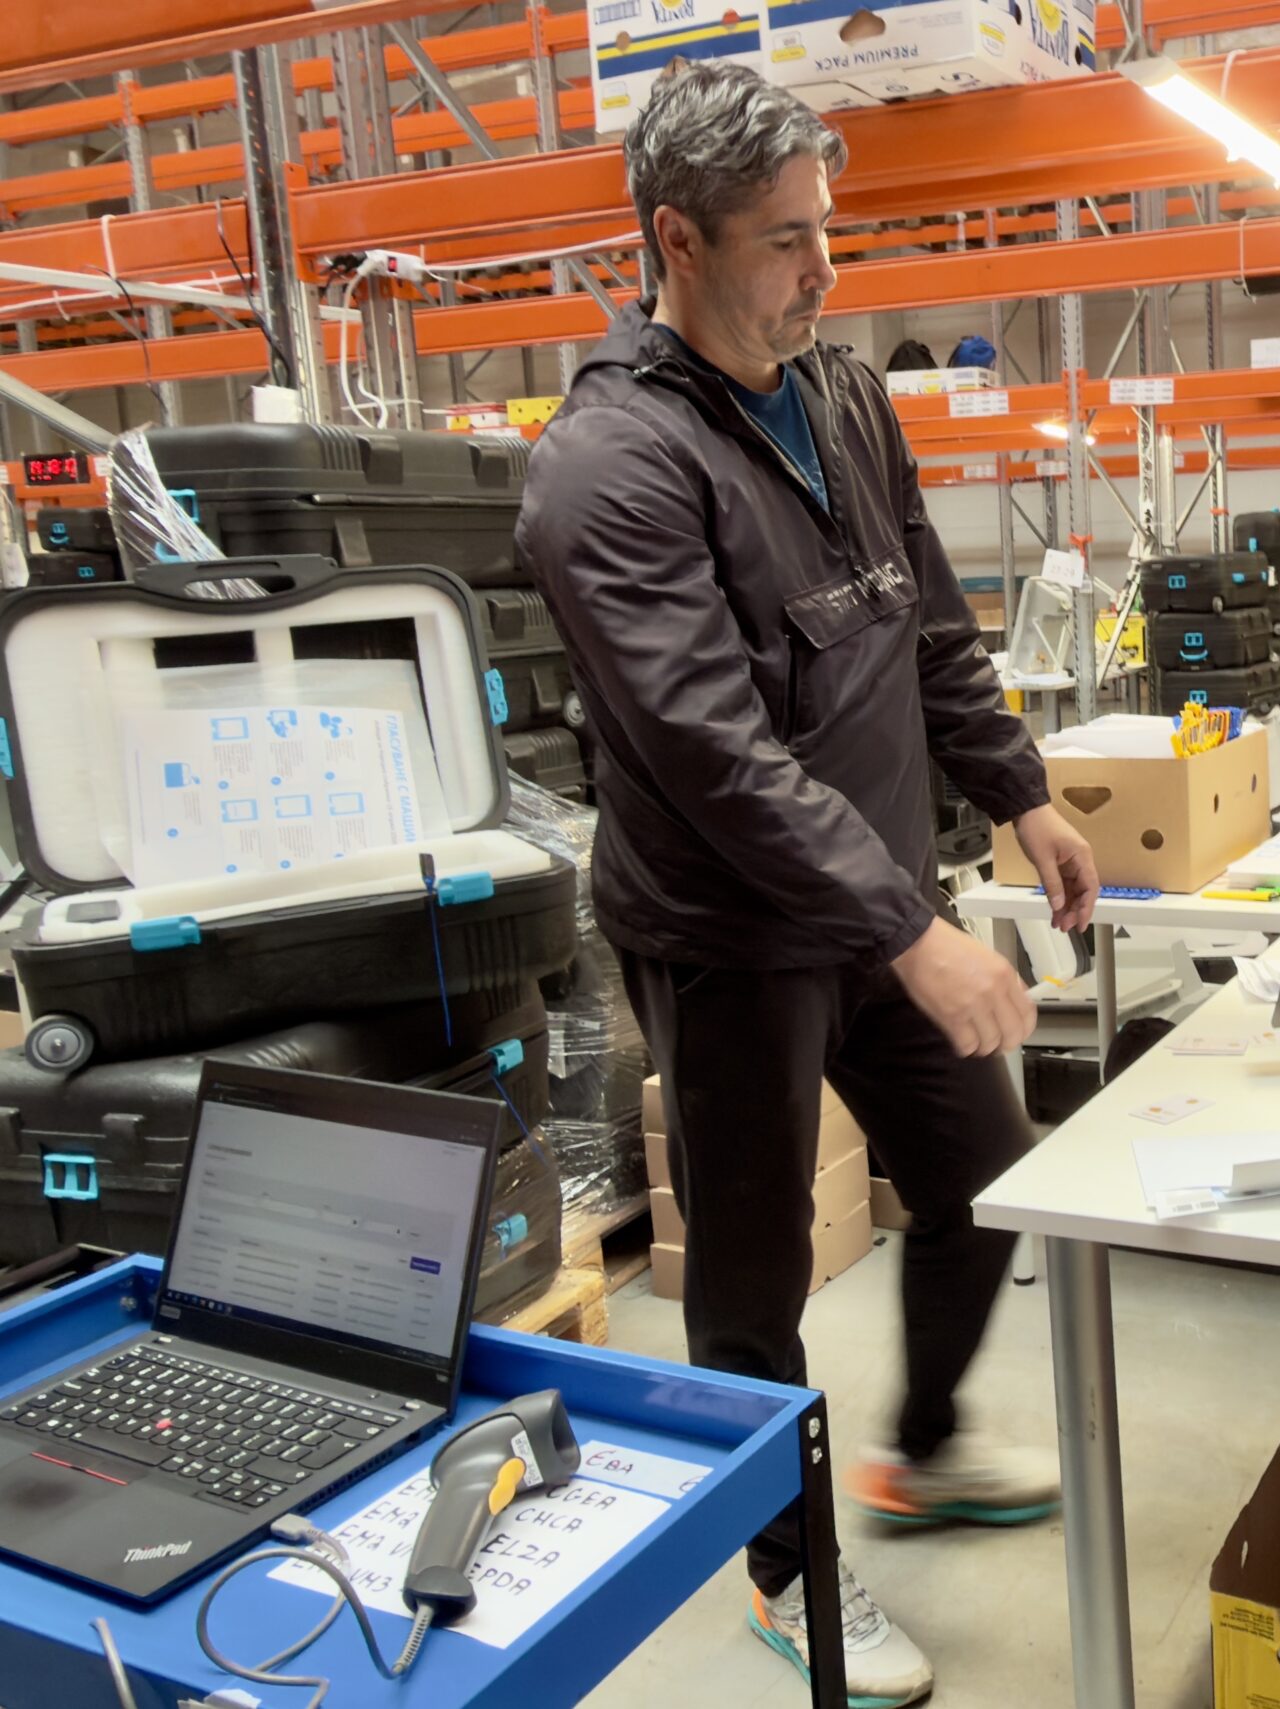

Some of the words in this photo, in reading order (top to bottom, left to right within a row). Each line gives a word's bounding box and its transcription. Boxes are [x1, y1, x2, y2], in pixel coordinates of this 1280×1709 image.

[815, 54, 849, 72] PACK
[854, 44, 919, 64] PREMIUM
[123, 1540, 193, 1563] ThinkPad
